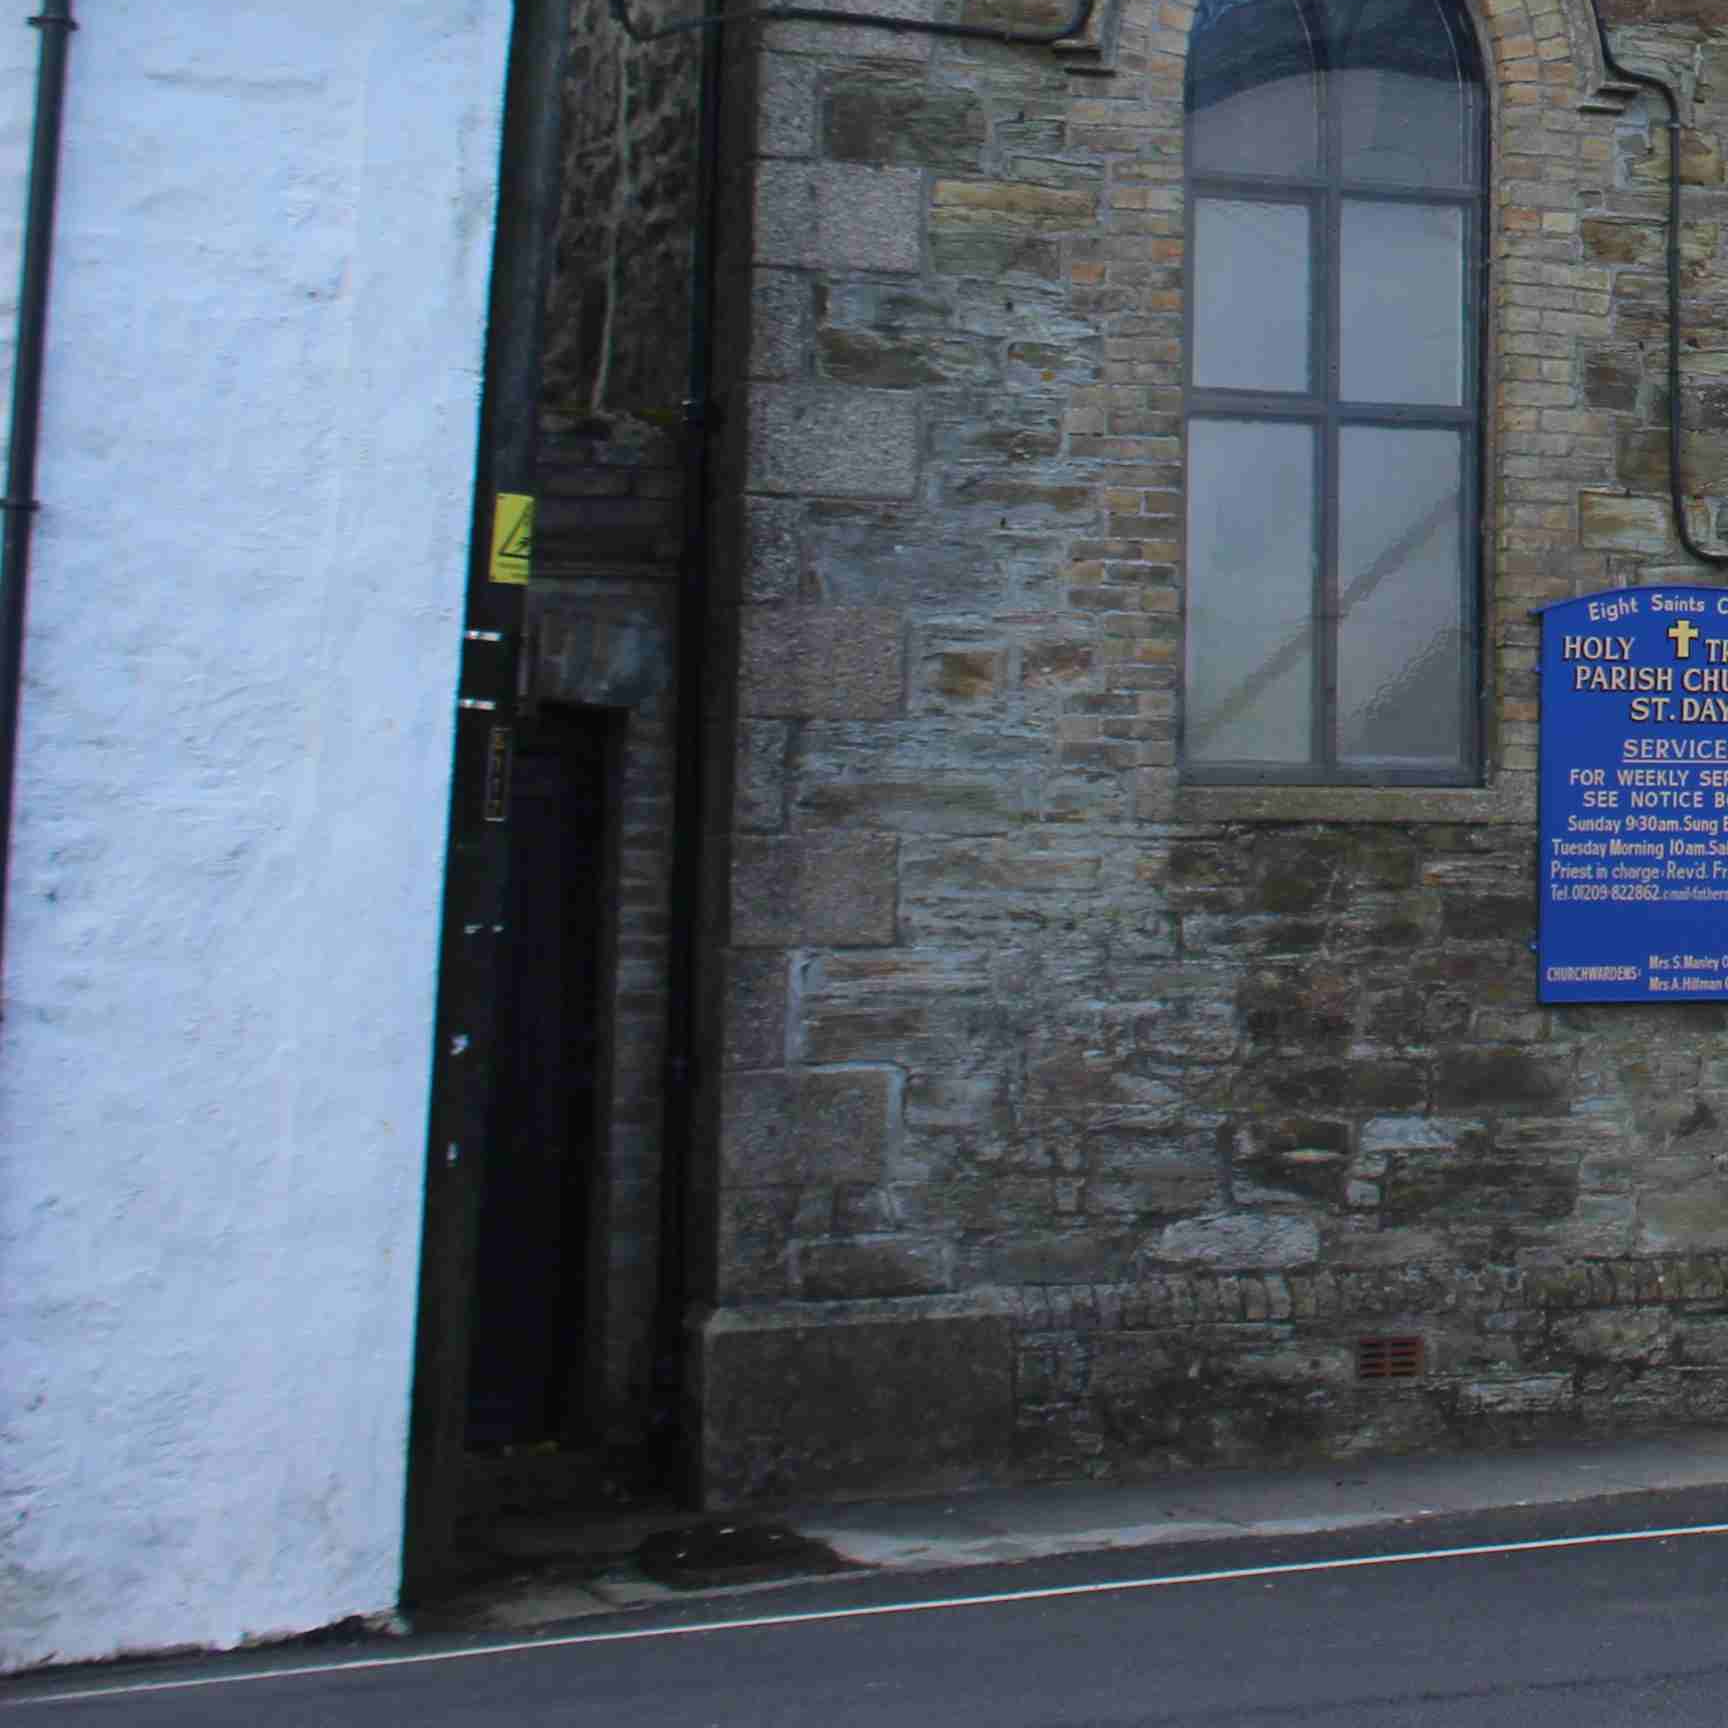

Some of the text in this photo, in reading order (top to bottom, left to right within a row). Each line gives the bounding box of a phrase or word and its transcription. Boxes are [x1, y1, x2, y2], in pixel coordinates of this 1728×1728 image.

[1588, 598, 1638, 622] Eight
[1651, 594, 1705, 612] Saints
[1563, 635, 1635, 661] HOLY
[1575, 666, 1673, 692] PARISH
[1631, 697, 1676, 721] ST.
[1569, 769, 1605, 786] FOR
[1617, 770, 1688, 787] WEEKLY
[1583, 791, 1618, 807] SEE
[1631, 792, 1704, 808] NOTICE
[1567, 815, 1621, 834] Sunday
[1683, 815, 1718, 835] Sung
[1552, 838, 1607, 858] Tuesday
[1609, 838, 1664, 859] Morning
[1551, 860, 1593, 880] Priest
[1595, 862, 1608, 880] in
